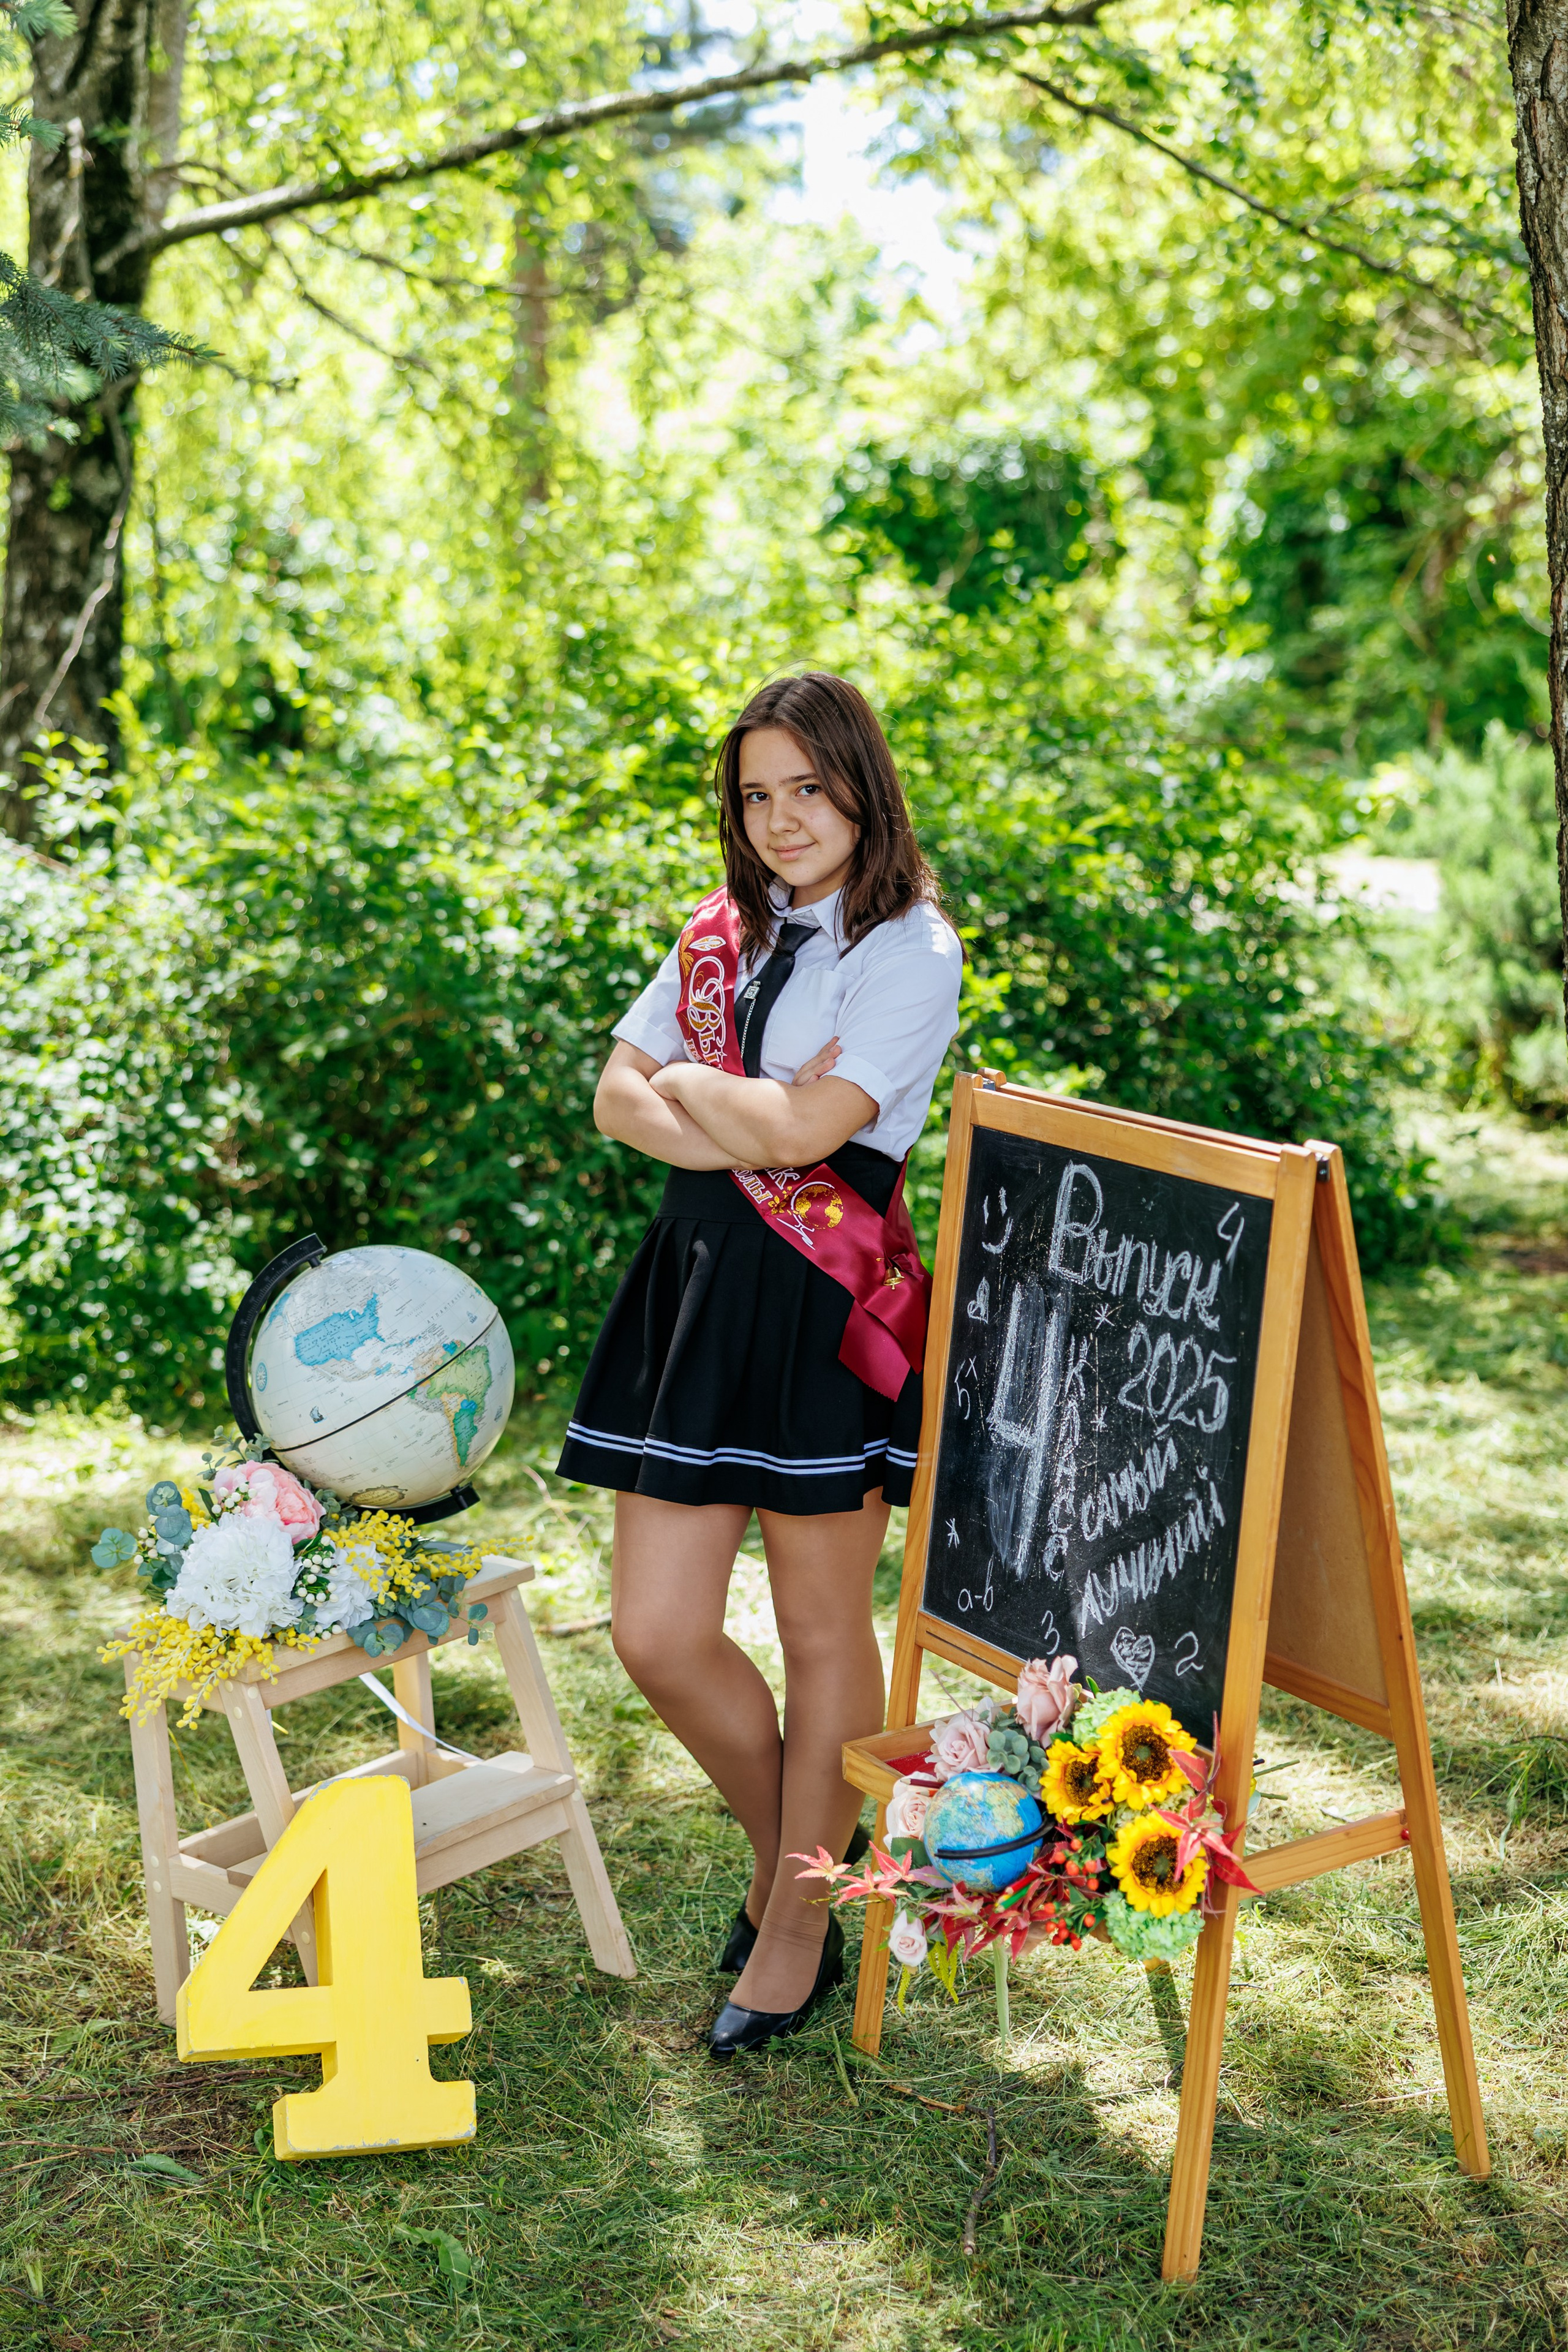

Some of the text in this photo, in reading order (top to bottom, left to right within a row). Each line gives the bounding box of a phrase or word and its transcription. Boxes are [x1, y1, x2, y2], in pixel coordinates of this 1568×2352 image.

[1216, 1202, 1245, 1268] 4
[1118, 1321, 1237, 1433] 2025
[986, 1281, 1058, 1581] 4
[1041, 1610, 1060, 1655] 3
[1174, 1630, 1204, 1677] 2
[176, 1774, 477, 2161] 4
